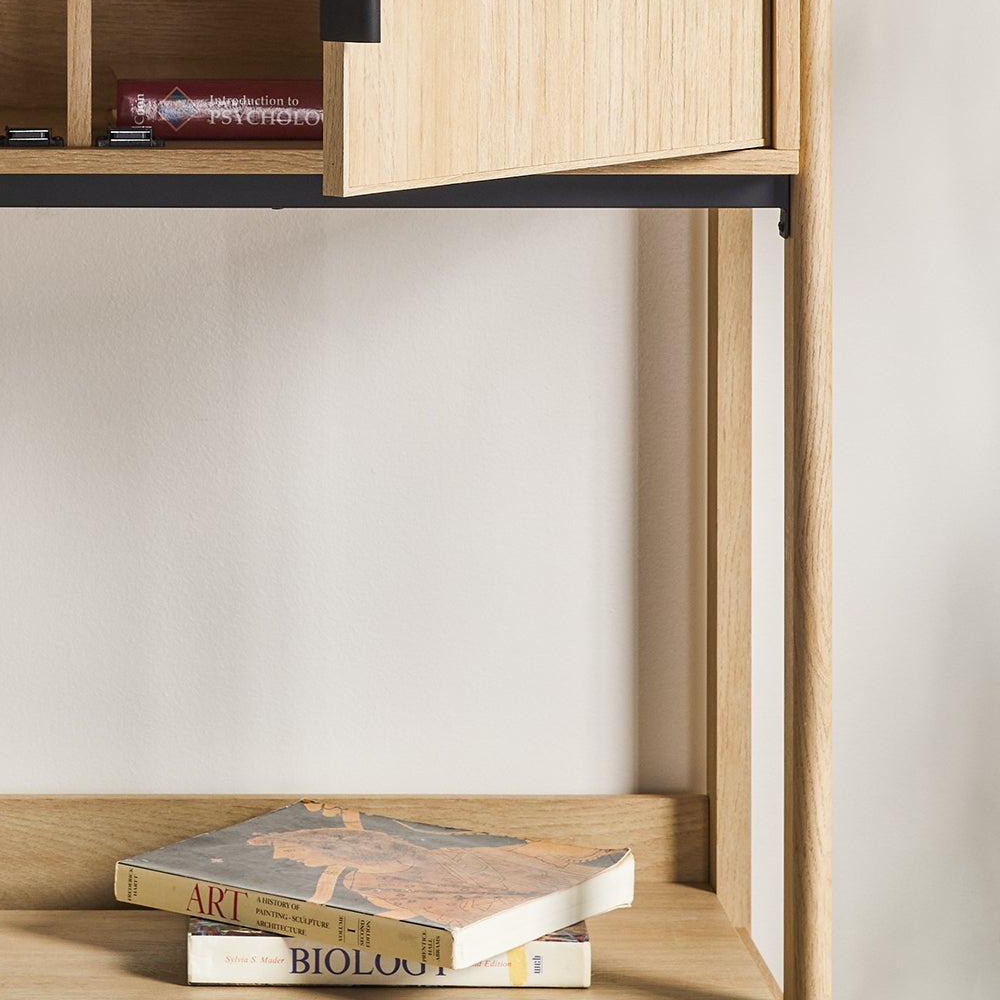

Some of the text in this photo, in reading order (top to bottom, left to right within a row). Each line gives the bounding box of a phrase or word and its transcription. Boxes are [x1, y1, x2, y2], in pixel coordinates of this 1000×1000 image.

[209, 95, 299, 107] Introduction to
[186, 882, 249, 922] ART
[256, 896, 300, 911] A HISTORY OF
[255, 907, 329, 929] PAINTING SCULPTURE
[256, 920, 305, 936] ARCHITECTURE
[261, 956, 285, 964] Mader
[484, 959, 512, 968] Edition
